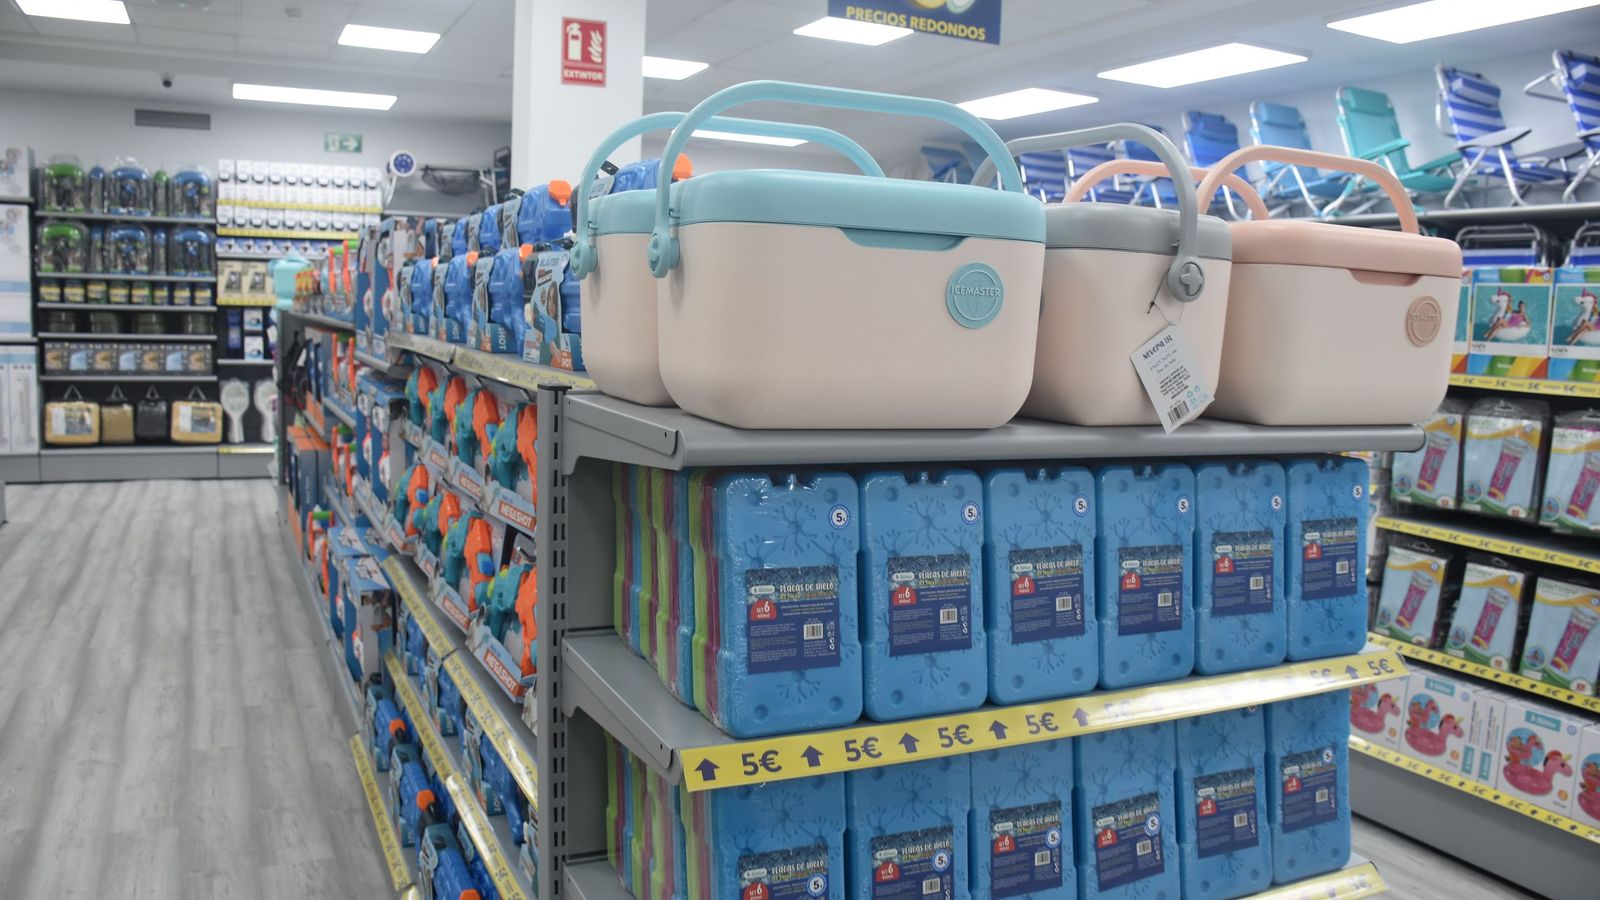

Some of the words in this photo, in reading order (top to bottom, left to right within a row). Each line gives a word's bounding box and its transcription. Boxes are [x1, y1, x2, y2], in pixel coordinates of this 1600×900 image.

[846, 6, 907, 27] PRECIOS
[910, 16, 986, 41] REDONDOS
[564, 69, 602, 80] EXTINTOR
[951, 285, 1001, 297] ICEMASTER
[742, 750, 782, 776] 5€
[844, 737, 882, 762] 5€
[938, 724, 974, 748] 5€
[1025, 712, 1059, 734] 5€
[1367, 658, 1394, 676] 5€
